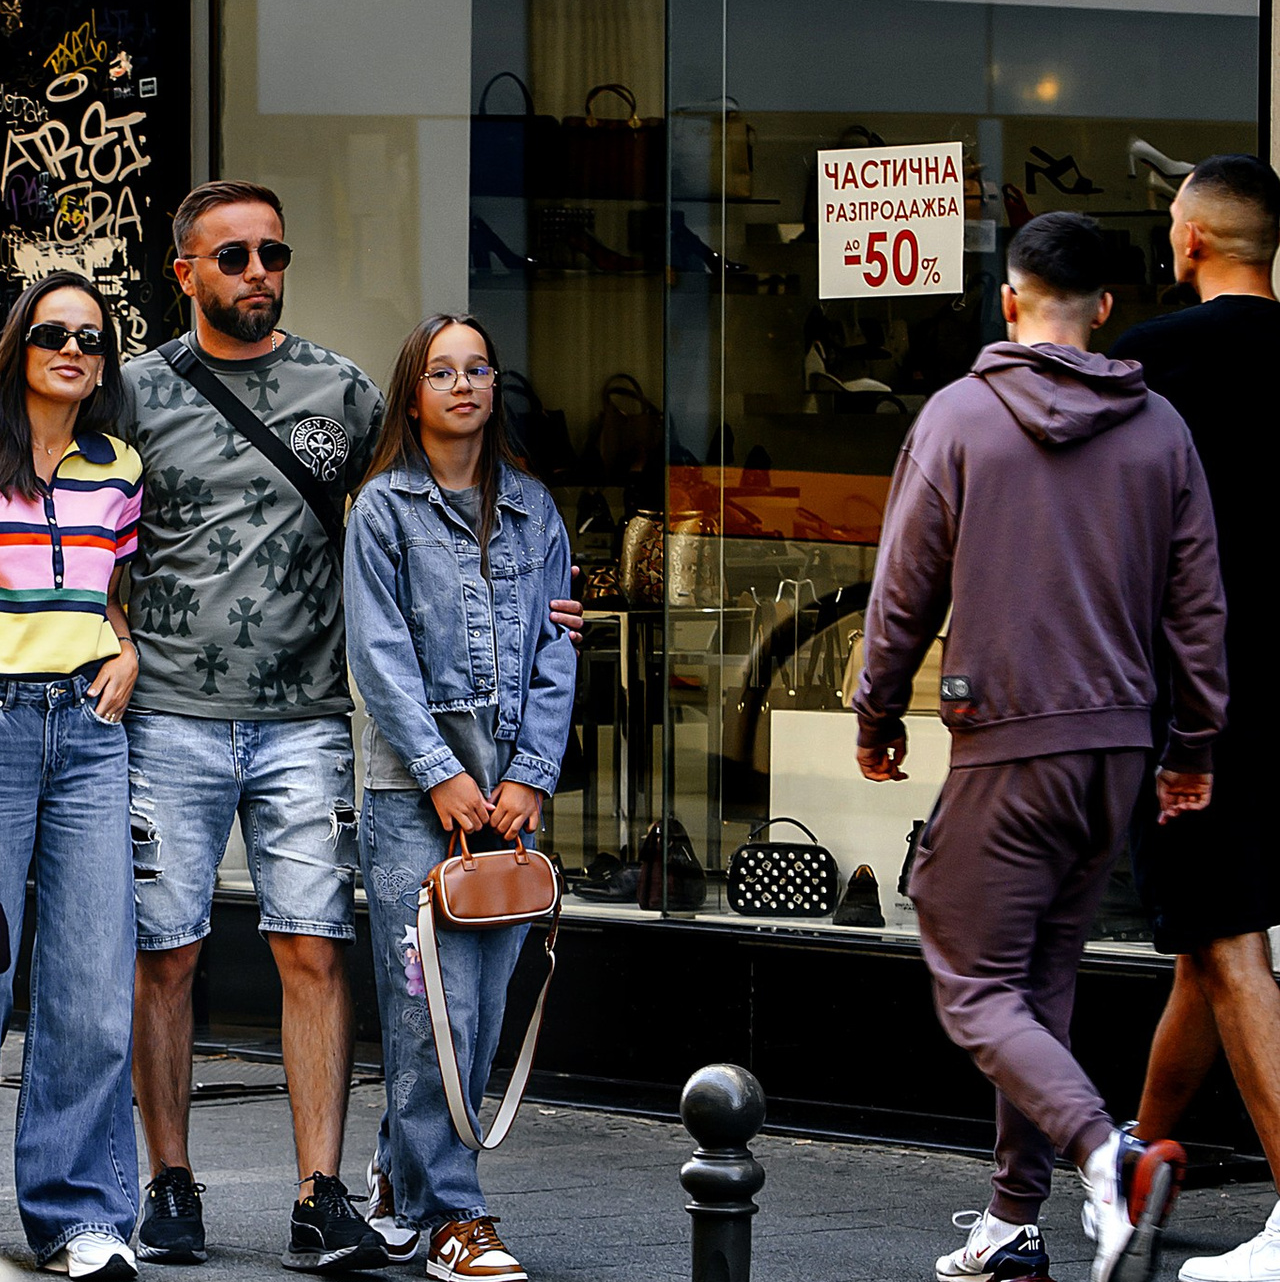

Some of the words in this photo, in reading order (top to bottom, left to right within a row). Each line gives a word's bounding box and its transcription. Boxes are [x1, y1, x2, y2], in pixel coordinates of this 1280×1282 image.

[824, 155, 959, 190] ЧАСТИЧНА
[826, 197, 959, 222] РАЗПРОДАЖБА
[294, 420, 320, 451] BROKEN
[323, 420, 347, 458] HEARTS
